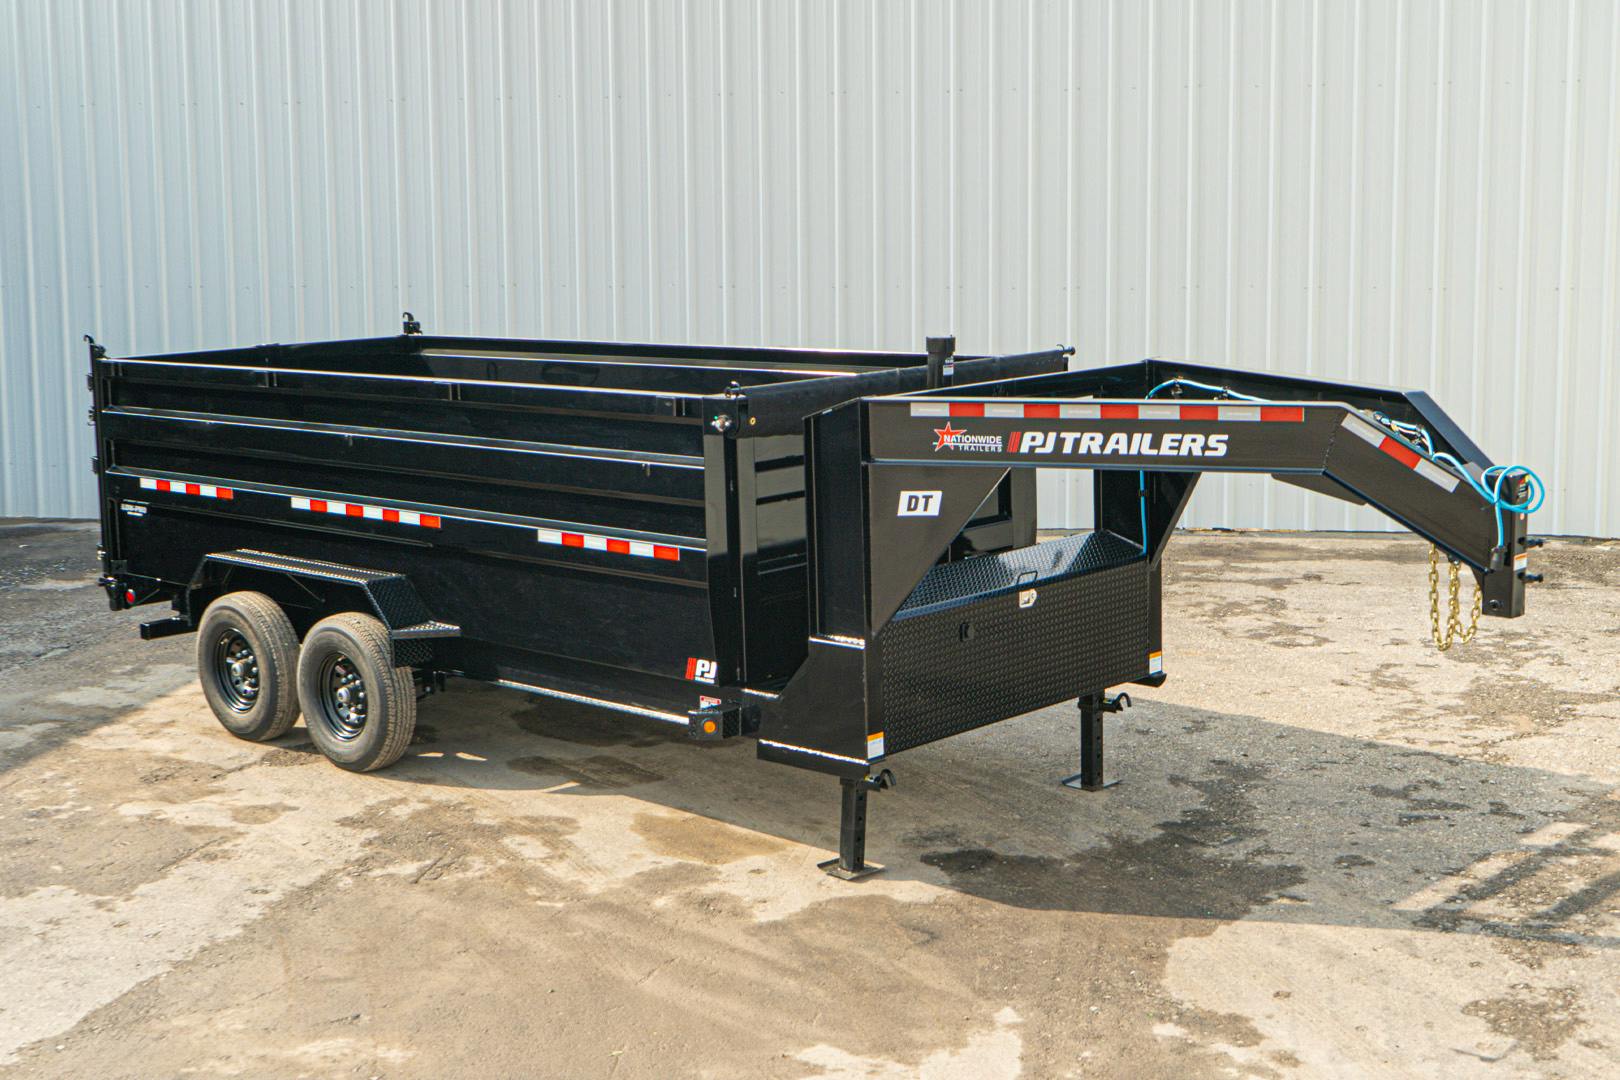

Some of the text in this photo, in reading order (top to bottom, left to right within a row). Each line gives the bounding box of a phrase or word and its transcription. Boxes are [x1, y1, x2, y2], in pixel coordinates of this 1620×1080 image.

[943, 435, 1003, 444] NATIONWIDE
[1019, 431, 1229, 457] PJ TRAILERS
[959, 445, 1003, 453] TRAILERS
[906, 494, 934, 512] DT
[695, 659, 718, 679] PJ
